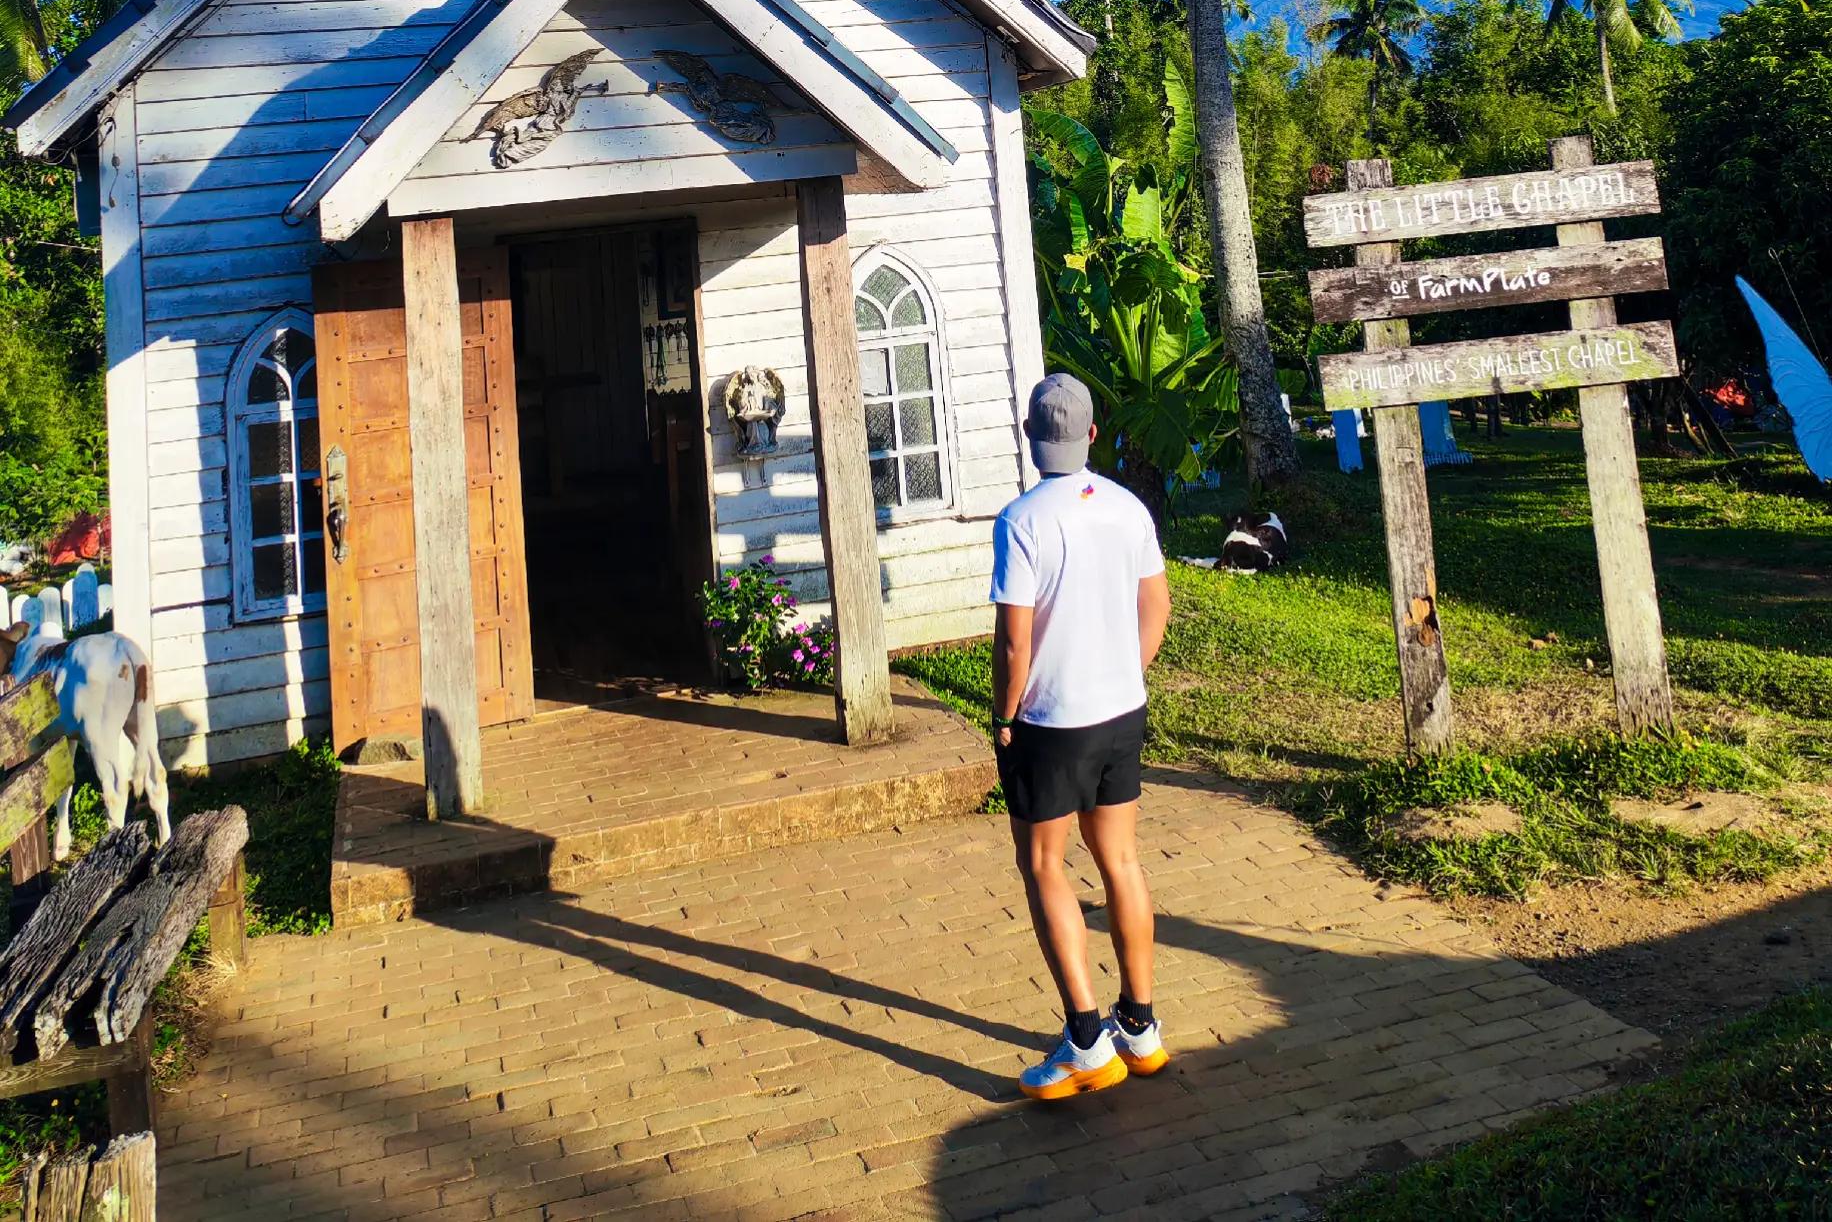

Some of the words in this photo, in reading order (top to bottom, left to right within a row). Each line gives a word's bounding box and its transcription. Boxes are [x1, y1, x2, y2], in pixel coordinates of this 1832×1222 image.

[1325, 199, 1388, 236] THE
[1394, 185, 1504, 228] LITTLE
[1511, 172, 1636, 214] CHAPEL
[1347, 358, 1460, 392] PHILIPPINES'
[1467, 347, 1562, 380] SMALLEST
[1567, 340, 1641, 369] CHAPEL
